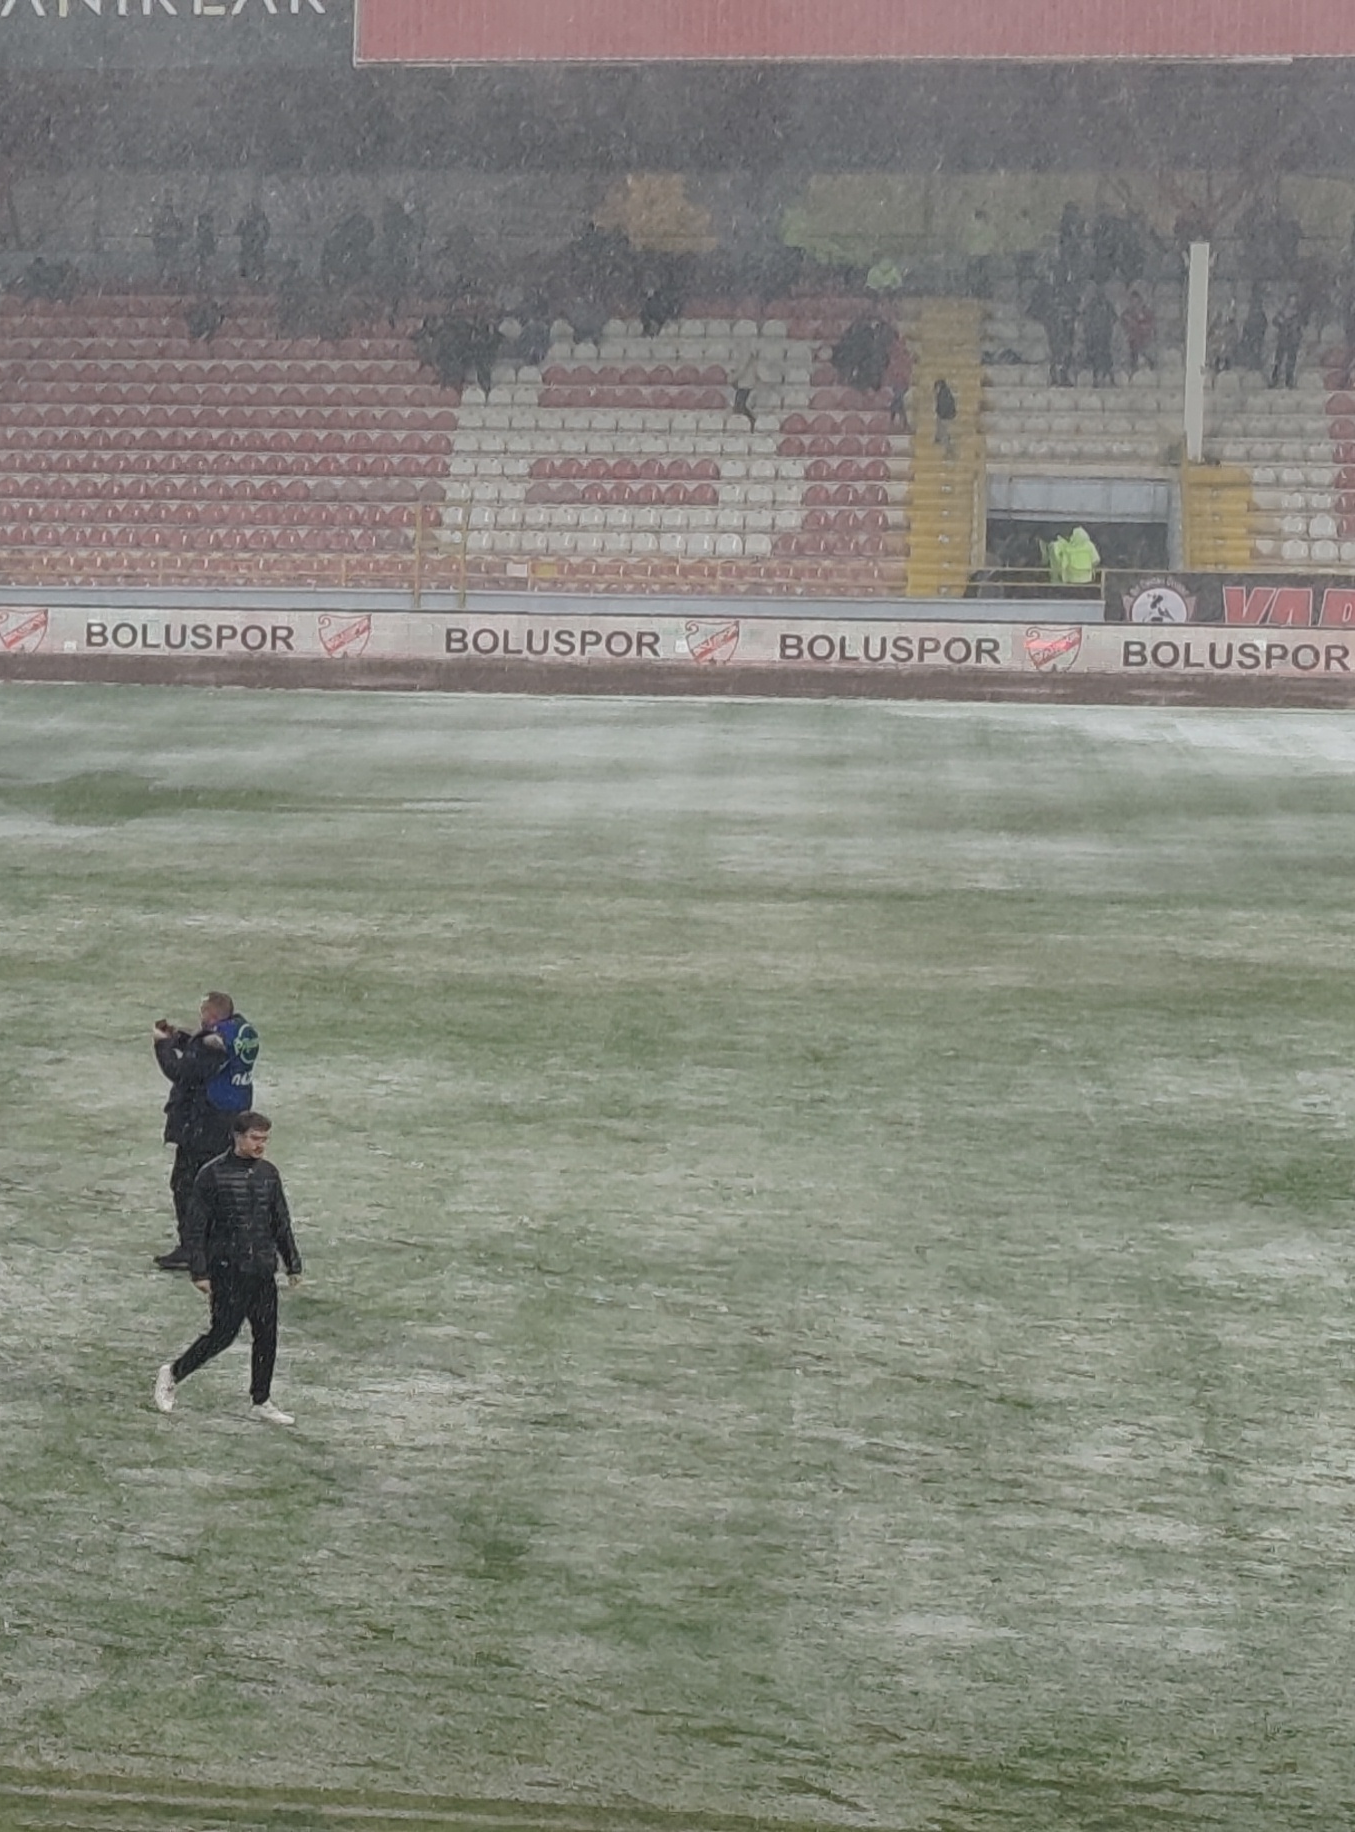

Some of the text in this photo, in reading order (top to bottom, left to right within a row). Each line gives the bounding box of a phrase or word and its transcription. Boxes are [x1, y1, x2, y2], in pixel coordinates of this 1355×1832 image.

[85, 622, 295, 652] BOLUSPOR
[444, 628, 661, 657] BOLUSPOR
[778, 633, 1002, 665] BOLUSPOR
[1122, 640, 1351, 671] BOLUSPOR
